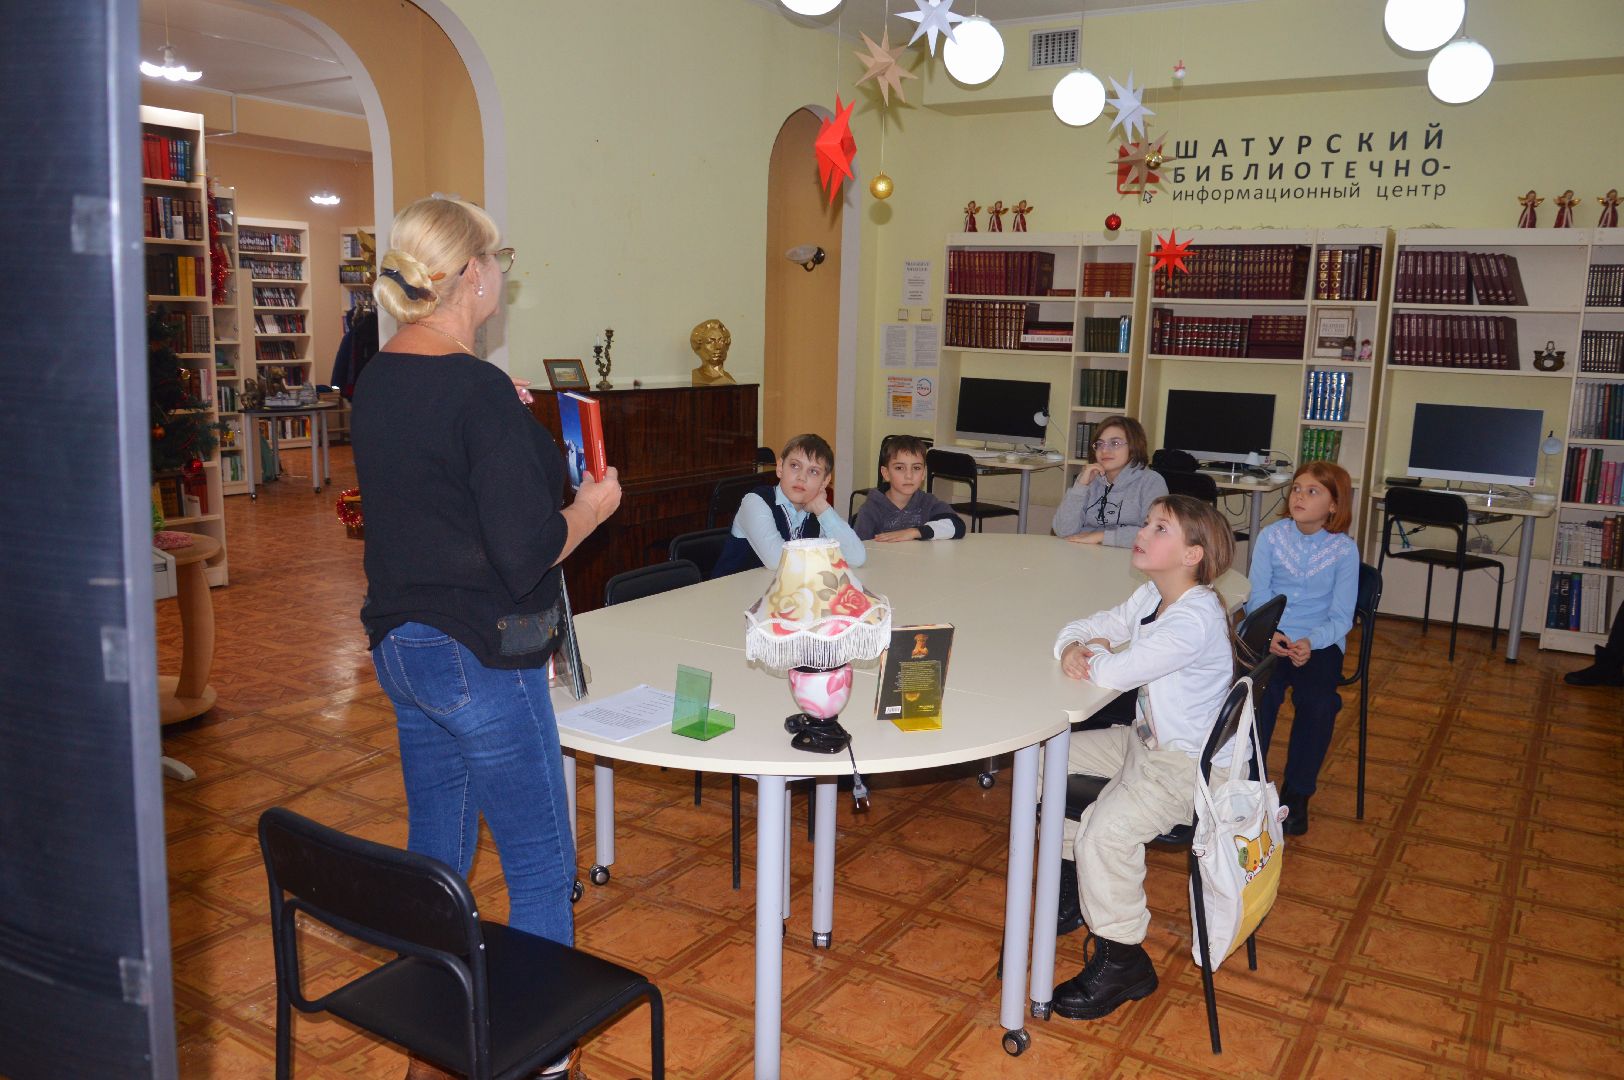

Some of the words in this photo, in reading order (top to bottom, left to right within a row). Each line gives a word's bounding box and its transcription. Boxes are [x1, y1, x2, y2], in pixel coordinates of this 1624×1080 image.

[1175, 122, 1444, 159] ШАТУРСКИЙ
[1173, 157, 1451, 184] БИБЛИОТЕЧНО-
[1172, 182, 1361, 205] информационный
[1376, 183, 1447, 201] центр
